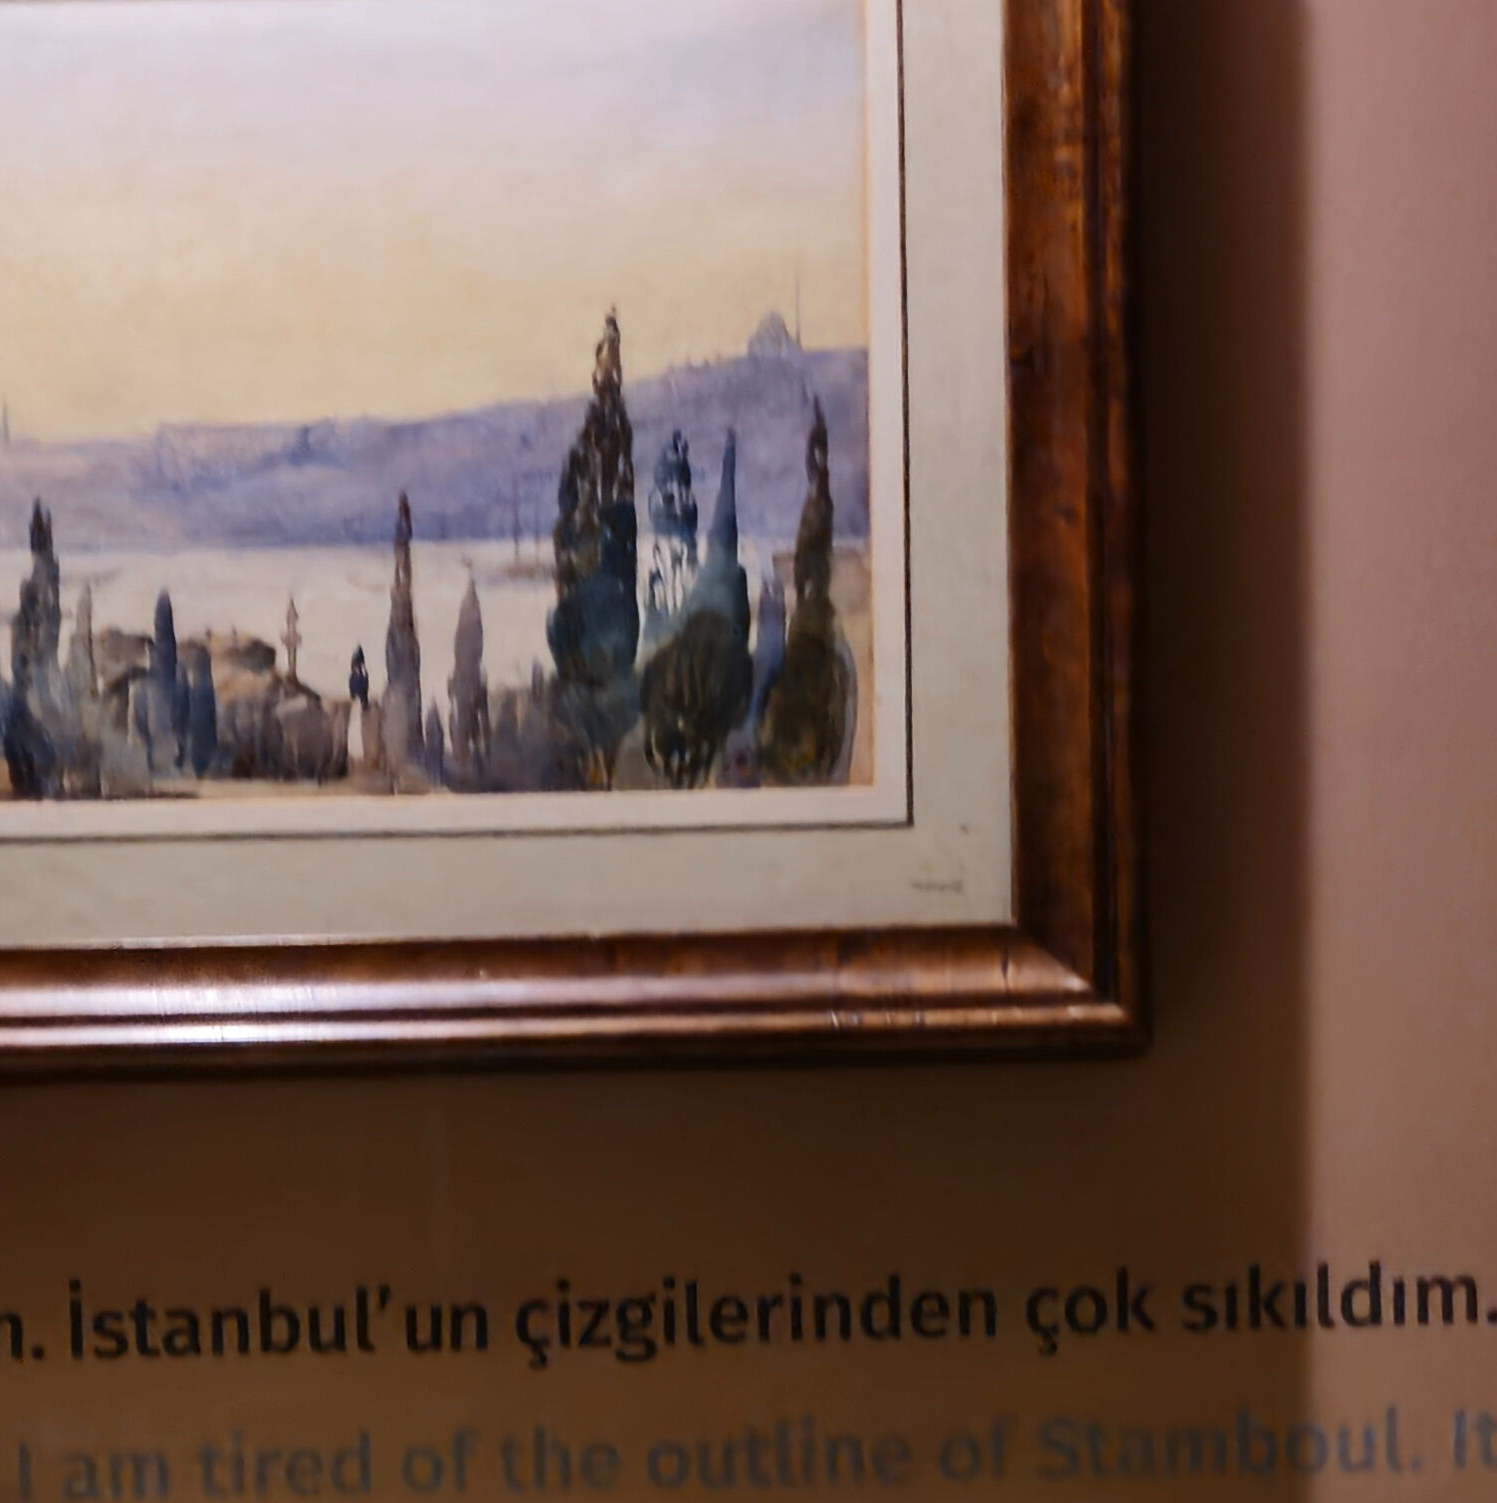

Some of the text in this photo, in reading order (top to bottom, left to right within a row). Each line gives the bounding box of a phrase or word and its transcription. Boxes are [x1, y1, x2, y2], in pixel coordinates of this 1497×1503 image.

[514, 1272, 998, 1371] çizgilerinden
[1024, 1264, 1157, 1357] çok
[16, 1438, 33, 1503] I
[61, 1447, 172, 1502] am
[198, 1427, 373, 1501] tired
[401, 1426, 478, 1497] of
[498, 1422, 622, 1494] the
[645, 1412, 913, 1491] outline
[938, 1410, 1018, 1485] of
[1038, 1404, 1426, 1480] Stamboul.
